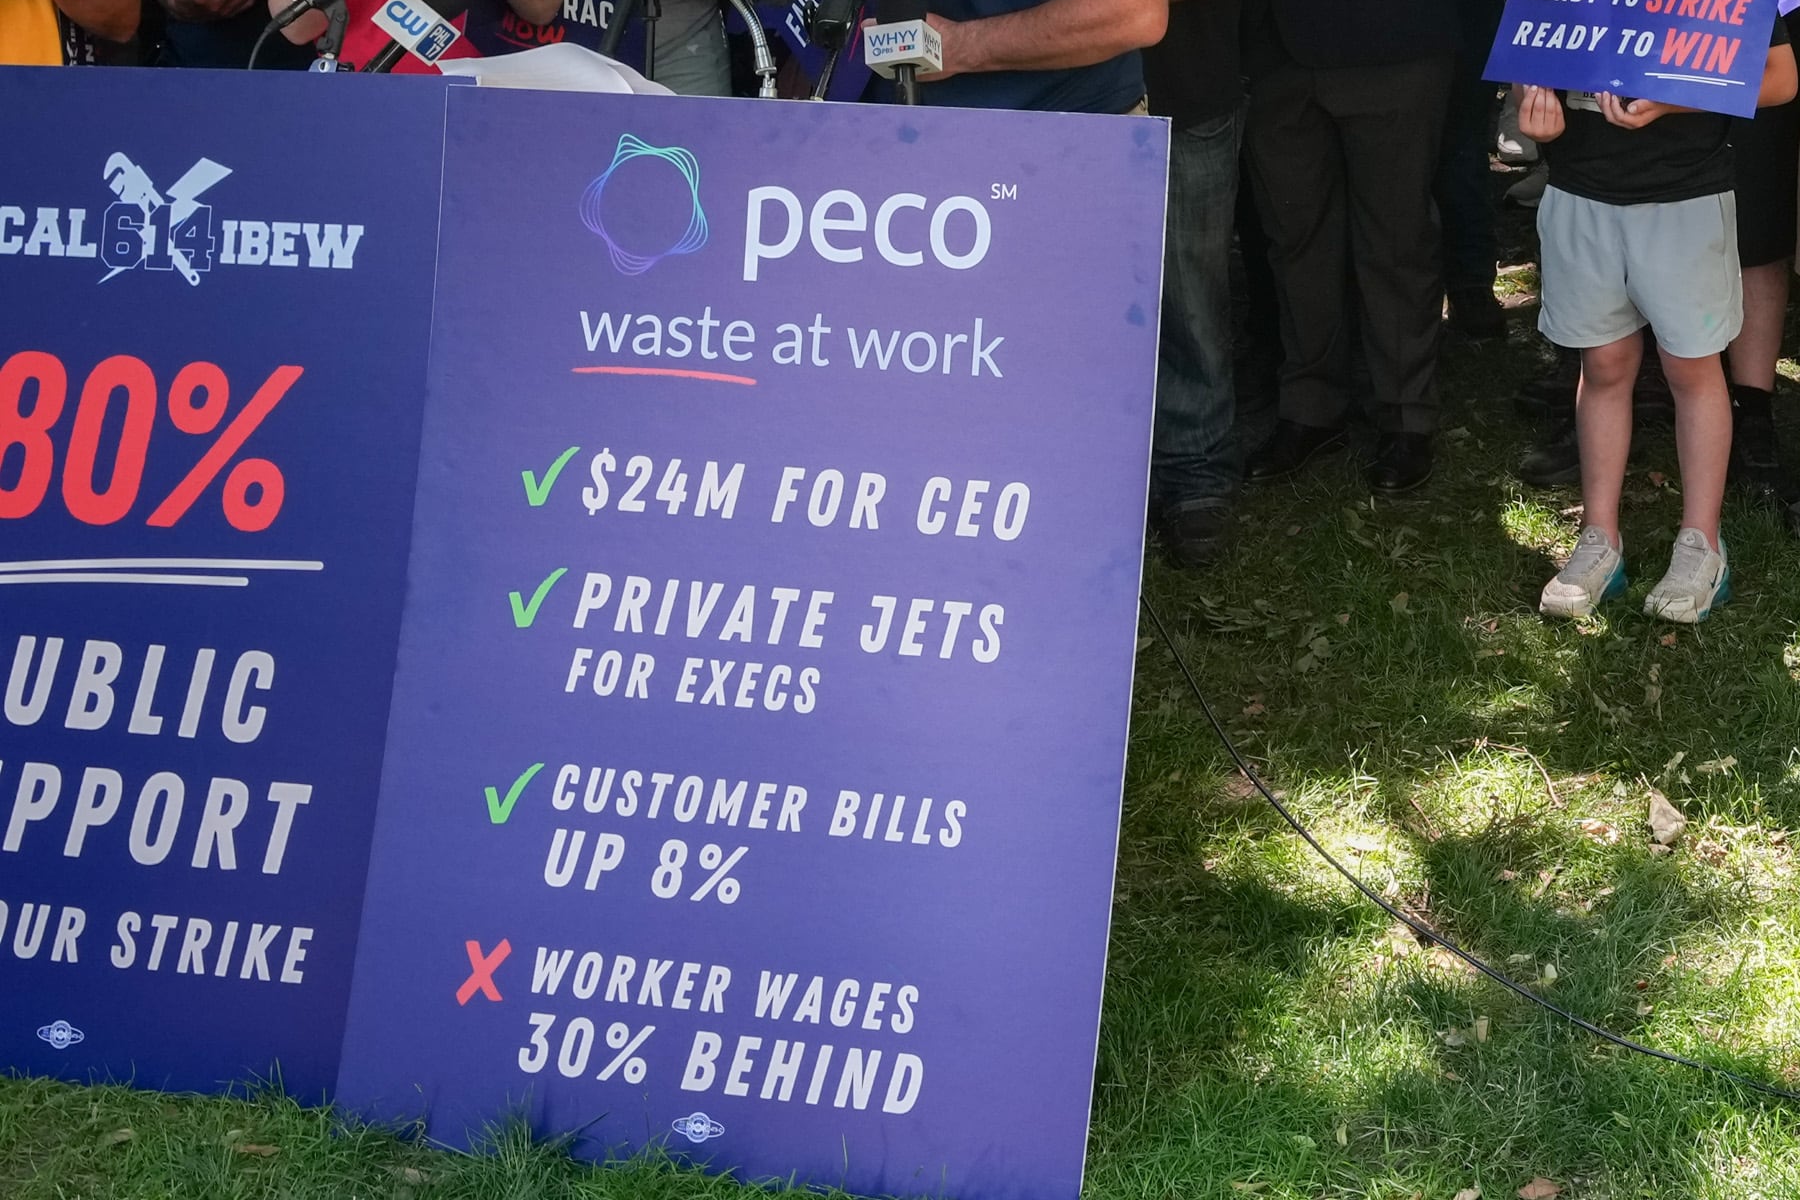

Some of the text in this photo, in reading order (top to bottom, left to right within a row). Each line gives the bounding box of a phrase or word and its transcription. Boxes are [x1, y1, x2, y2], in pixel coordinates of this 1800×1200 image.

[427, 41, 443, 59] 17
[430, 25, 450, 48] PHL
[868, 29, 918, 47] WHYY
[924, 31, 941, 52] WHYY
[1512, 20, 1741, 75] READY TO WIN
[0, 201, 364, 272] CAL 614 IBEW
[743, 183, 1017, 282] peco SM
[579, 305, 1005, 378] waste at work
[0, 350, 304, 534] 80%
[582, 447, 1031, 542] $24M FOR CEO
[573, 572, 1005, 664] PRIVATE JETS
[3, 635, 275, 744] UBLIC
[565, 647, 821, 714] FOR EXECS
[0, 760, 313, 875] PPORT
[551, 764, 967, 848] CUSTOMER BILLS
[543, 828, 750, 905] UP 8%
[110, 910, 314, 984] STRIKE
[531, 946, 920, 1034] WORKER WAGES
[518, 1012, 924, 1115] 30% BEHIND
